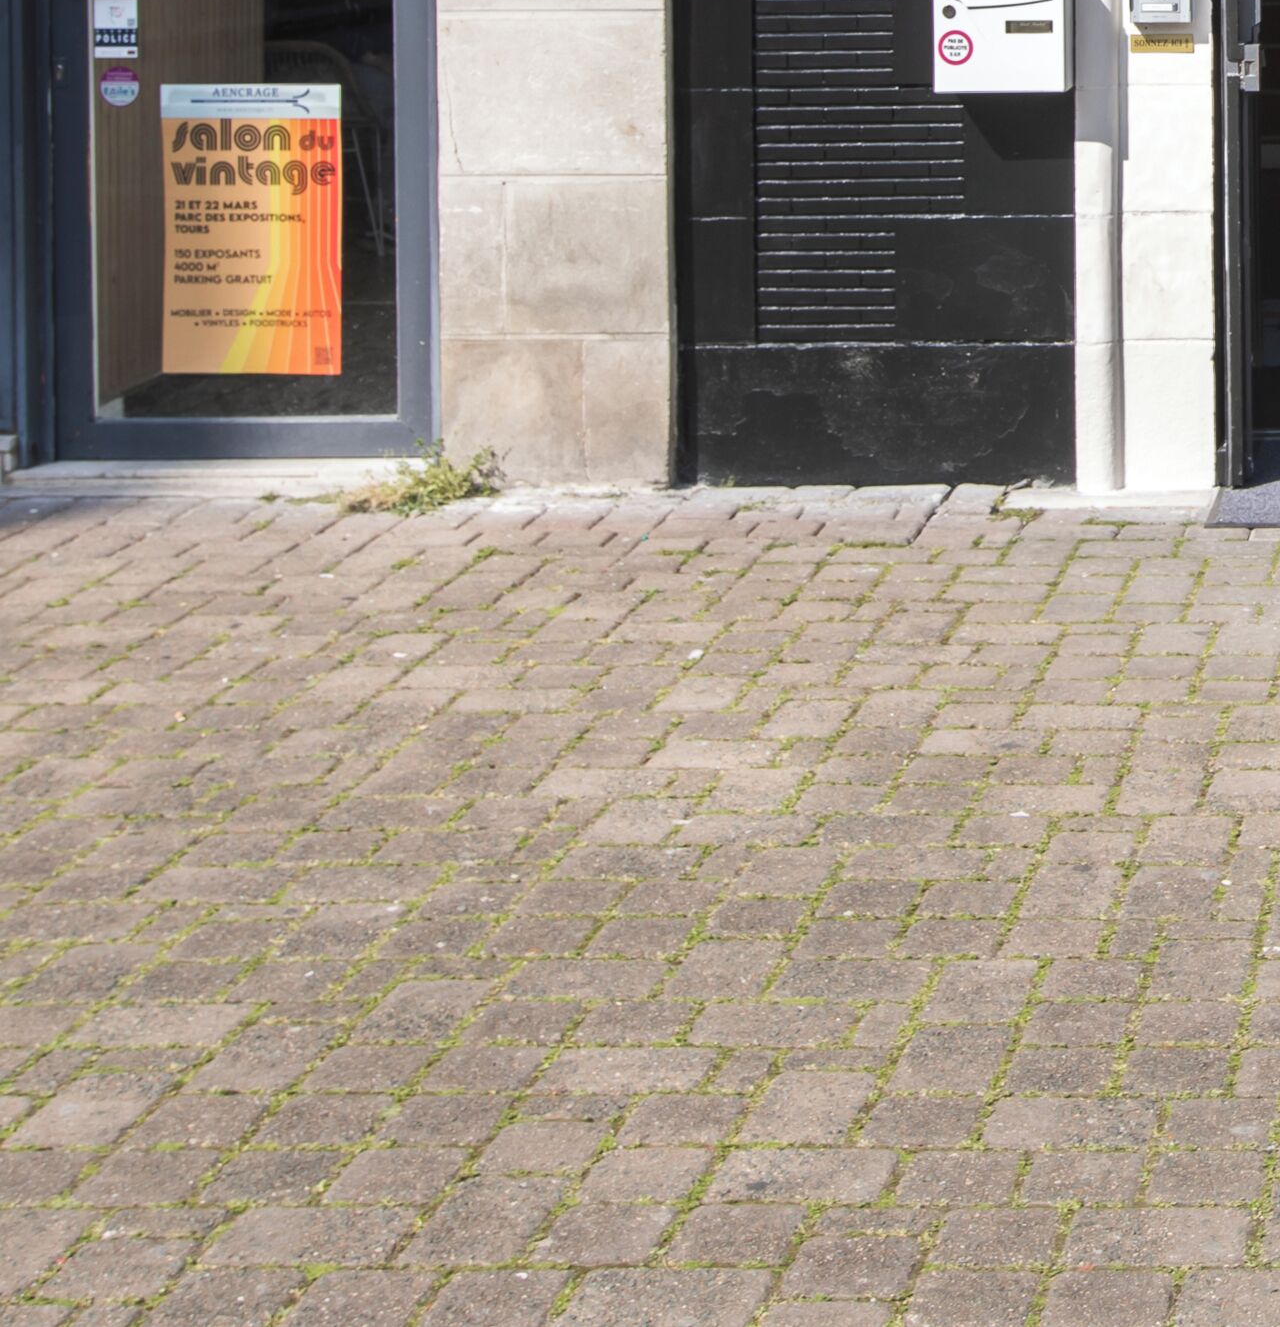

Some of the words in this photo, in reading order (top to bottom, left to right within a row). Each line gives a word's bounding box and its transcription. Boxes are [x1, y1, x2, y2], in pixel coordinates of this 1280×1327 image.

[95, 34, 136, 43] POLICE
[1134, 38, 1168, 48] SONNEZ
[1171, 39, 1182, 47] ICI
[212, 87, 280, 98] AENCRAGE
[298, 129, 335, 152] du
[170, 155, 336, 196] vintage
[174, 200, 186, 210] 21
[188, 200, 202, 210] ET
[205, 200, 219, 210] 22
[222, 200, 258, 210] MARS
[174, 213, 202, 222] PARC
[204, 213, 226, 222] DES
[228, 213, 306, 224] EXPOSITIONS,
[174, 225, 210, 234] TOURS
[174, 249, 191, 259] 150
[194, 249, 261, 259] EXPOSANTS
[174, 262, 204, 271] 4000
[174, 275, 222, 285] PARKING
[225, 275, 273, 285] GRATUIT
